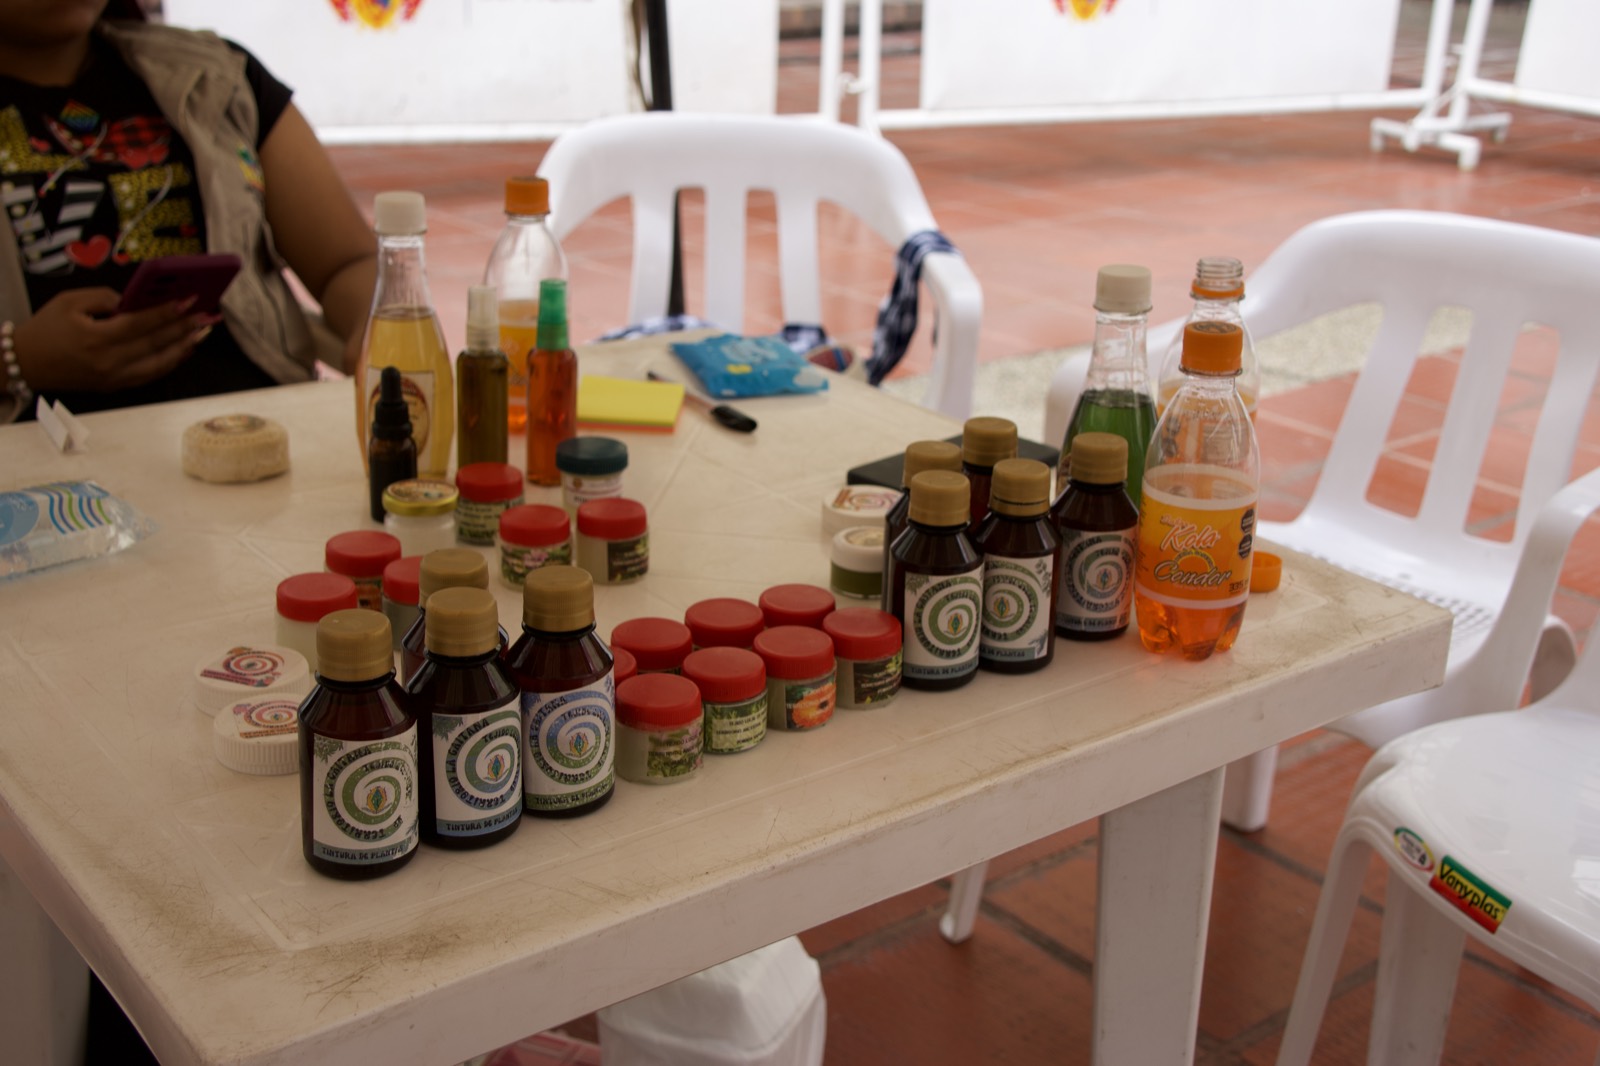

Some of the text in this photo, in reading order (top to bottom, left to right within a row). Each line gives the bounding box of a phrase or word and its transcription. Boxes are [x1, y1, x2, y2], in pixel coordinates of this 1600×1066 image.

[1160, 524, 1219, 552] Kola
[1154, 559, 1232, 587] Condor
[482, 728, 509, 743] TEJIDO
[445, 718, 506, 808] TERRITORIO LA GAITANA
[326, 800, 387, 840] TERRITORIO
[446, 822, 482, 832] TINTURA
[484, 820, 493, 828] DE
[322, 846, 358, 860] TINTURA
[1440, 861, 1500, 920] Vanyplas
